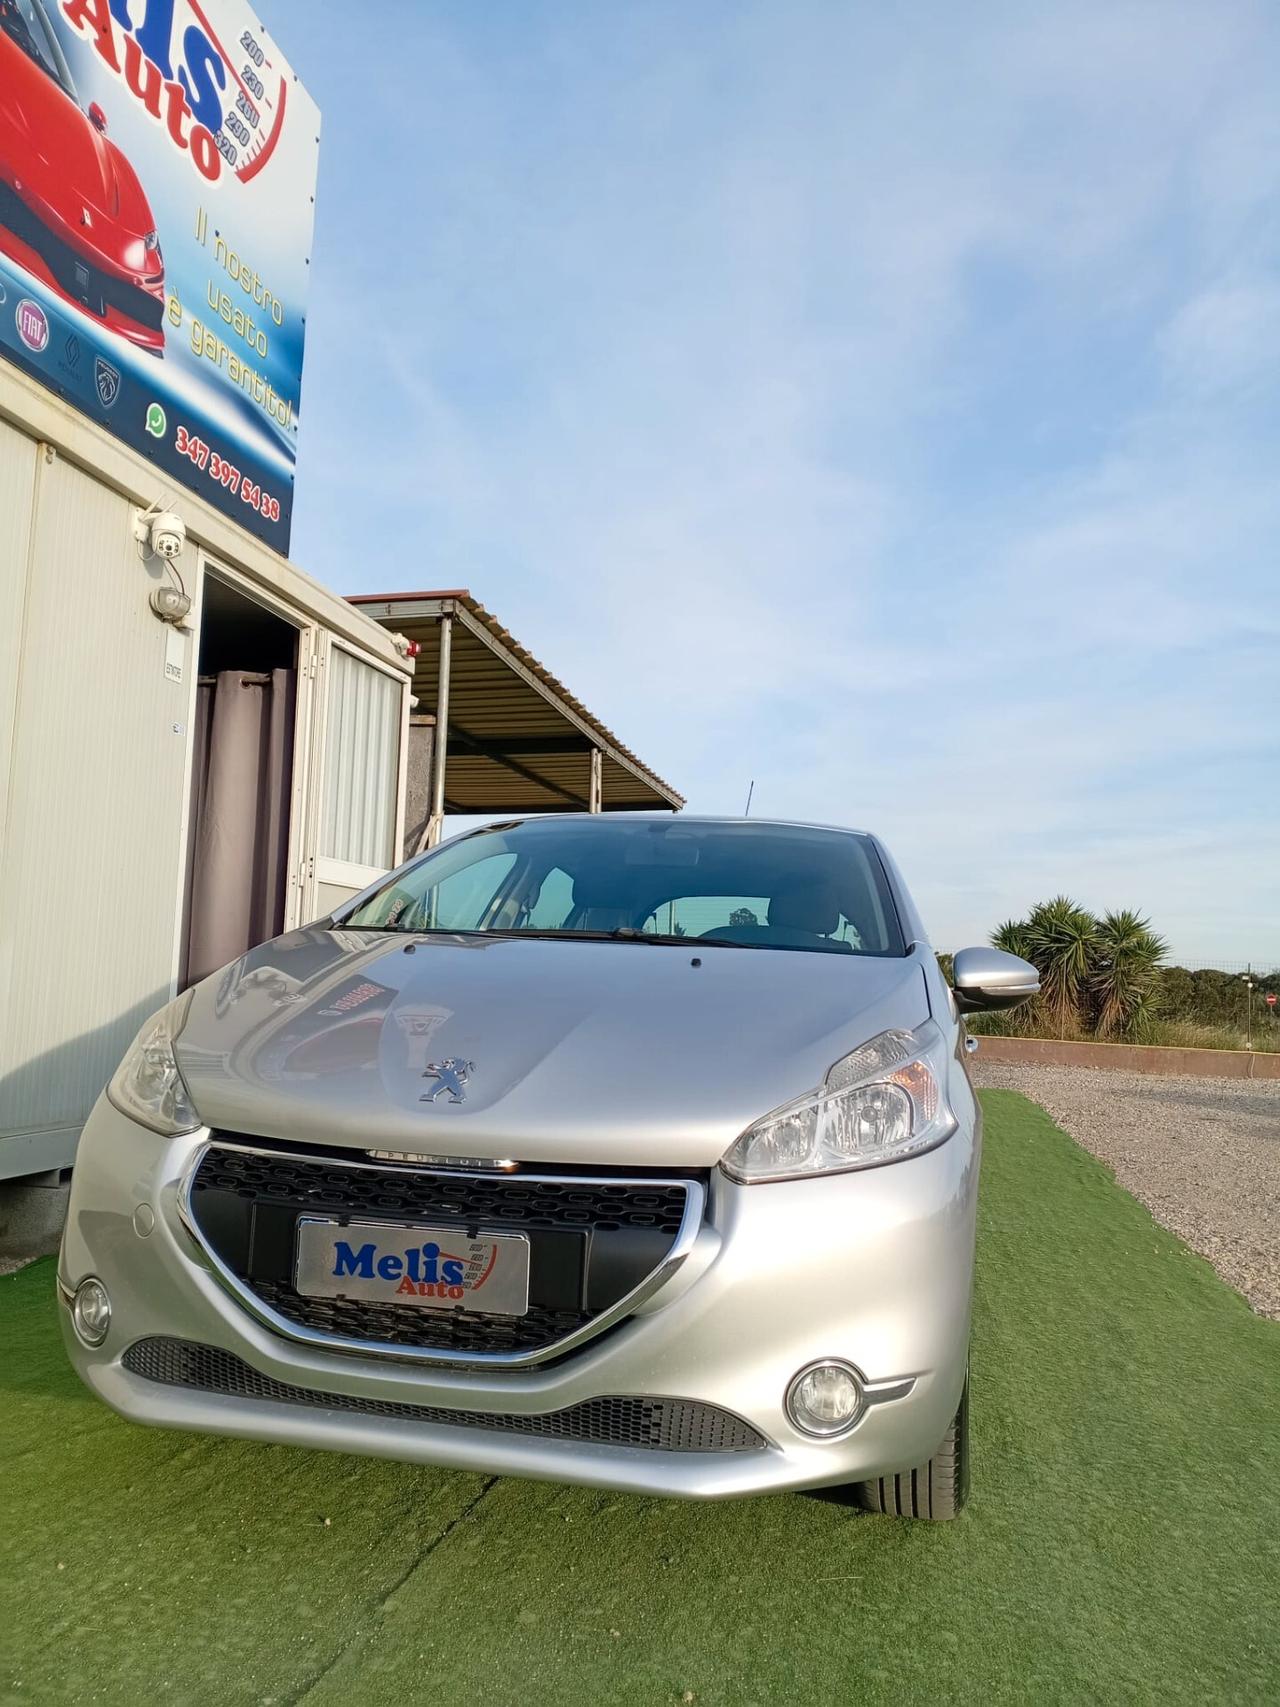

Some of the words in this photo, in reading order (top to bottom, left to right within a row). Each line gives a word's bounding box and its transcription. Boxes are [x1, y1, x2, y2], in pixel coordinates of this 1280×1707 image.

[240, 31, 264, 67] 200
[62, 0, 221, 181] Auto
[240, 65, 264, 100] 230
[213, 129, 237, 166] 320
[225, 111, 250, 147] 290
[214, 237, 283, 326] nostro
[23, 310, 42, 341] FIAT
[207, 279, 267, 358] usato
[191, 318, 292, 432] garantito!
[175, 425, 209, 470] 347
[209, 452, 240, 494] 397
[332, 1241, 464, 1286] Melis
[395, 1276, 465, 1300] Auto
